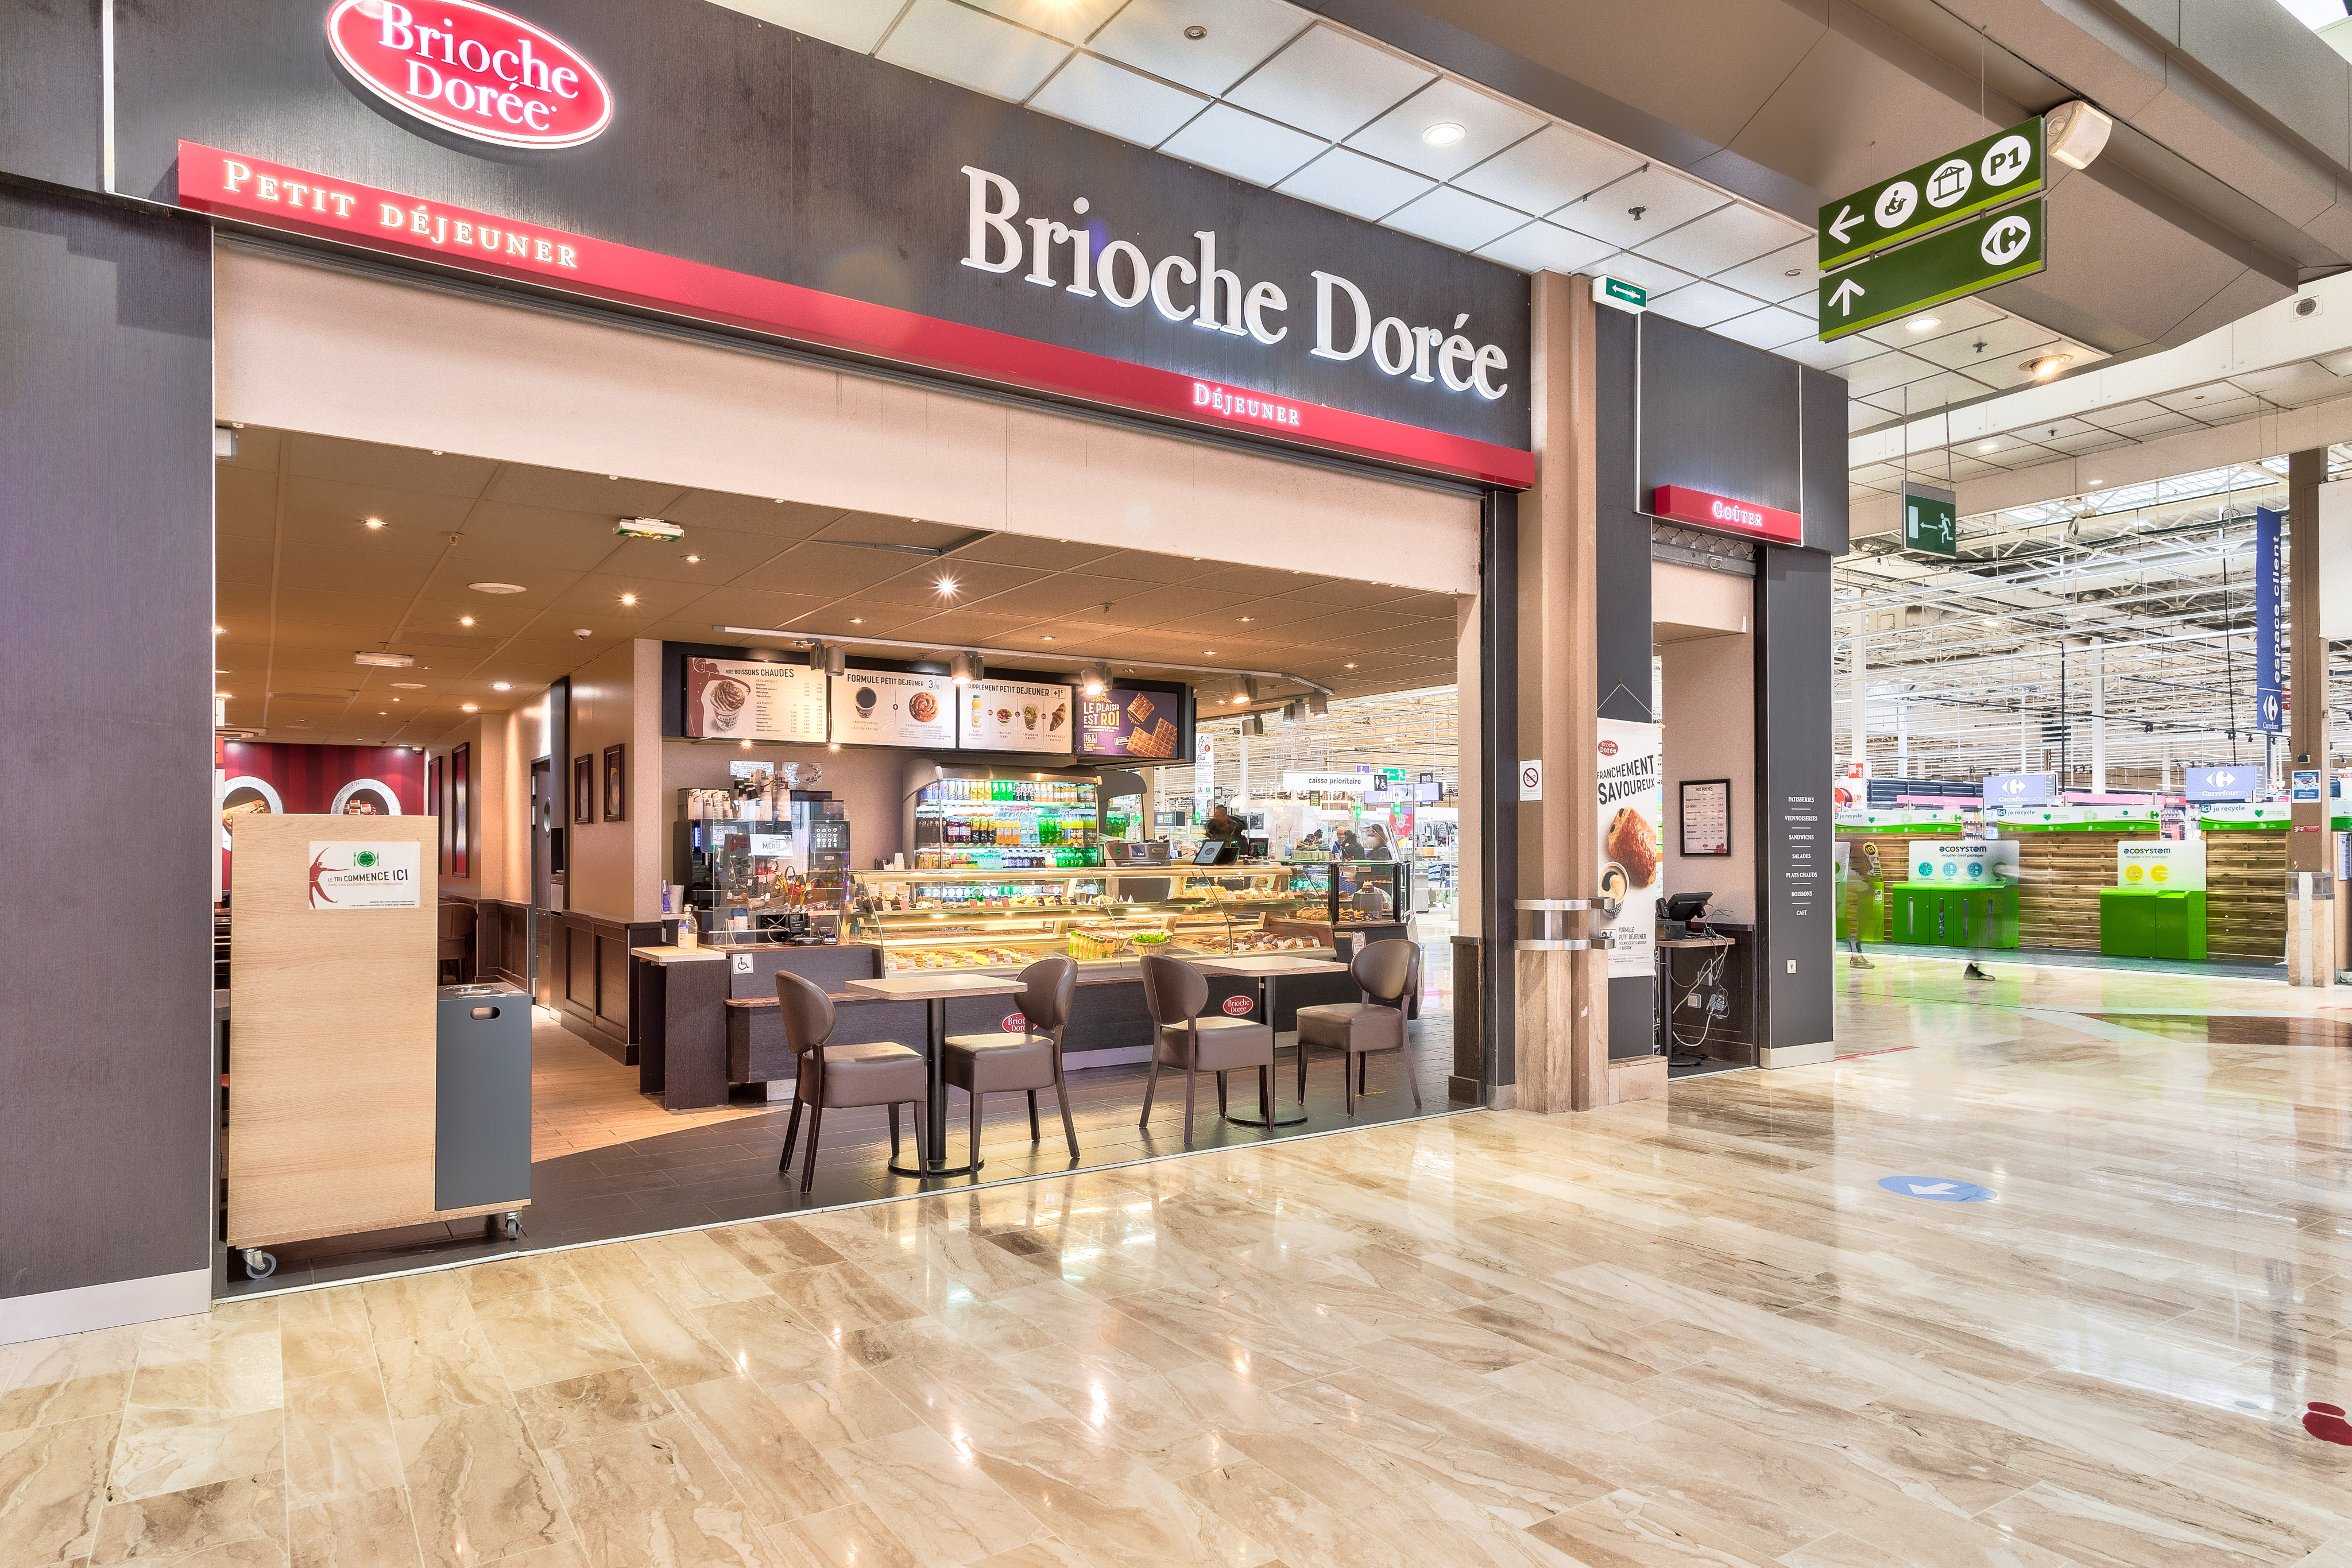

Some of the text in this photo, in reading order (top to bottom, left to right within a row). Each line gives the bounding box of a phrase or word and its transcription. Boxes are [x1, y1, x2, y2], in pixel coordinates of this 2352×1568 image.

[378, 0, 579, 99] Brioche
[405, 59, 550, 131] Dorée
[1990, 146, 2022, 177] P1
[223, 159, 355, 219] PETIT
[960, 165, 1508, 402] Brioche Dorée
[761, 669, 794, 677] CHAUDES
[847, 674, 879, 684] FORMULE
[881, 677, 898, 685] PETIT
[1084, 702, 1120, 715] LE PLAISIR
[1084, 711, 1120, 726] EST ROI
[2263, 722, 2278, 730] Carrefour
[1597, 754, 1654, 780] FRANCHEMENT
[1598, 778, 1655, 805] SAVOUREUX
[1866, 846, 1875, 854] ICI
[344, 871, 390, 882] COMMENCE
[393, 869, 408, 881] ICI
[1228, 998, 1250, 1007] Brioche
[1008, 1017, 1025, 1025] Brioc
